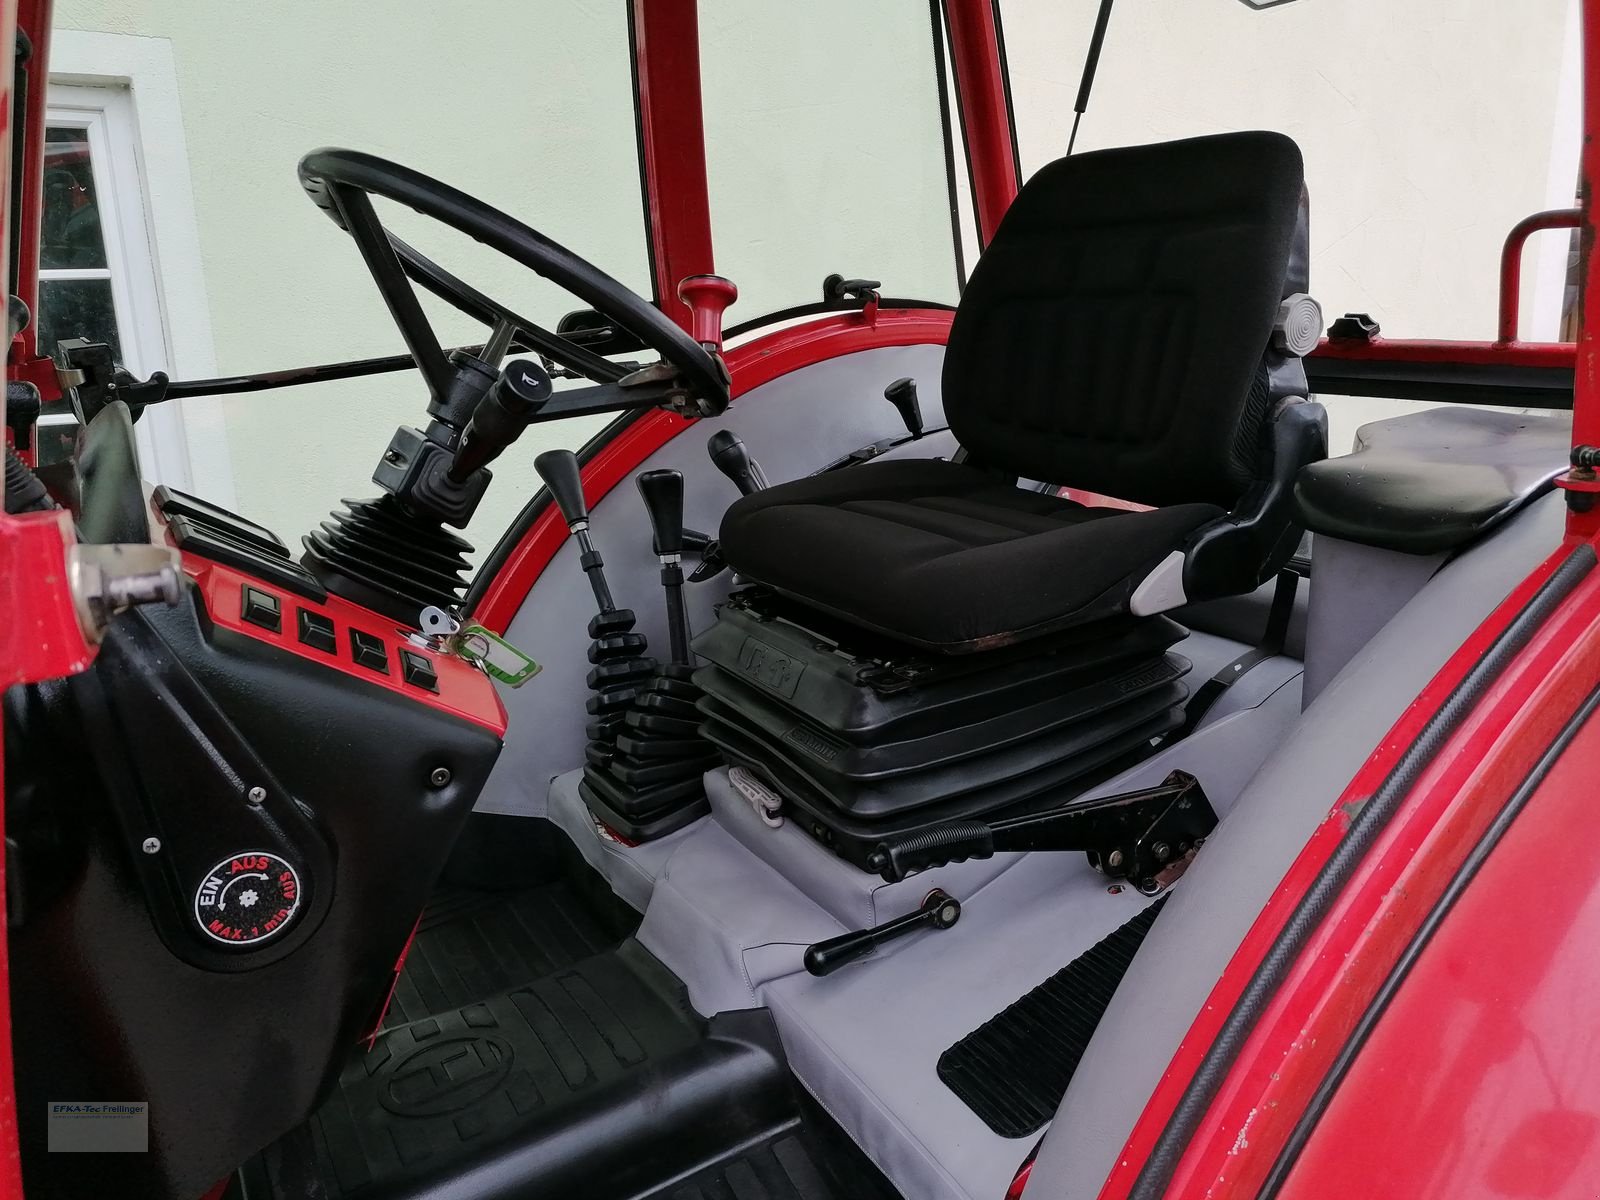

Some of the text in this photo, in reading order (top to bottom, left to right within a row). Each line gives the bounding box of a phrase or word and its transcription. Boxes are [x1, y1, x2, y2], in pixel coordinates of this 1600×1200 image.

[231, 856, 269, 875] AUS
[200, 876, 224, 906] EIN
[208, 919, 248, 940] MAX.
[251, 926, 259, 937] 1
[279, 871, 296, 900] AUS
